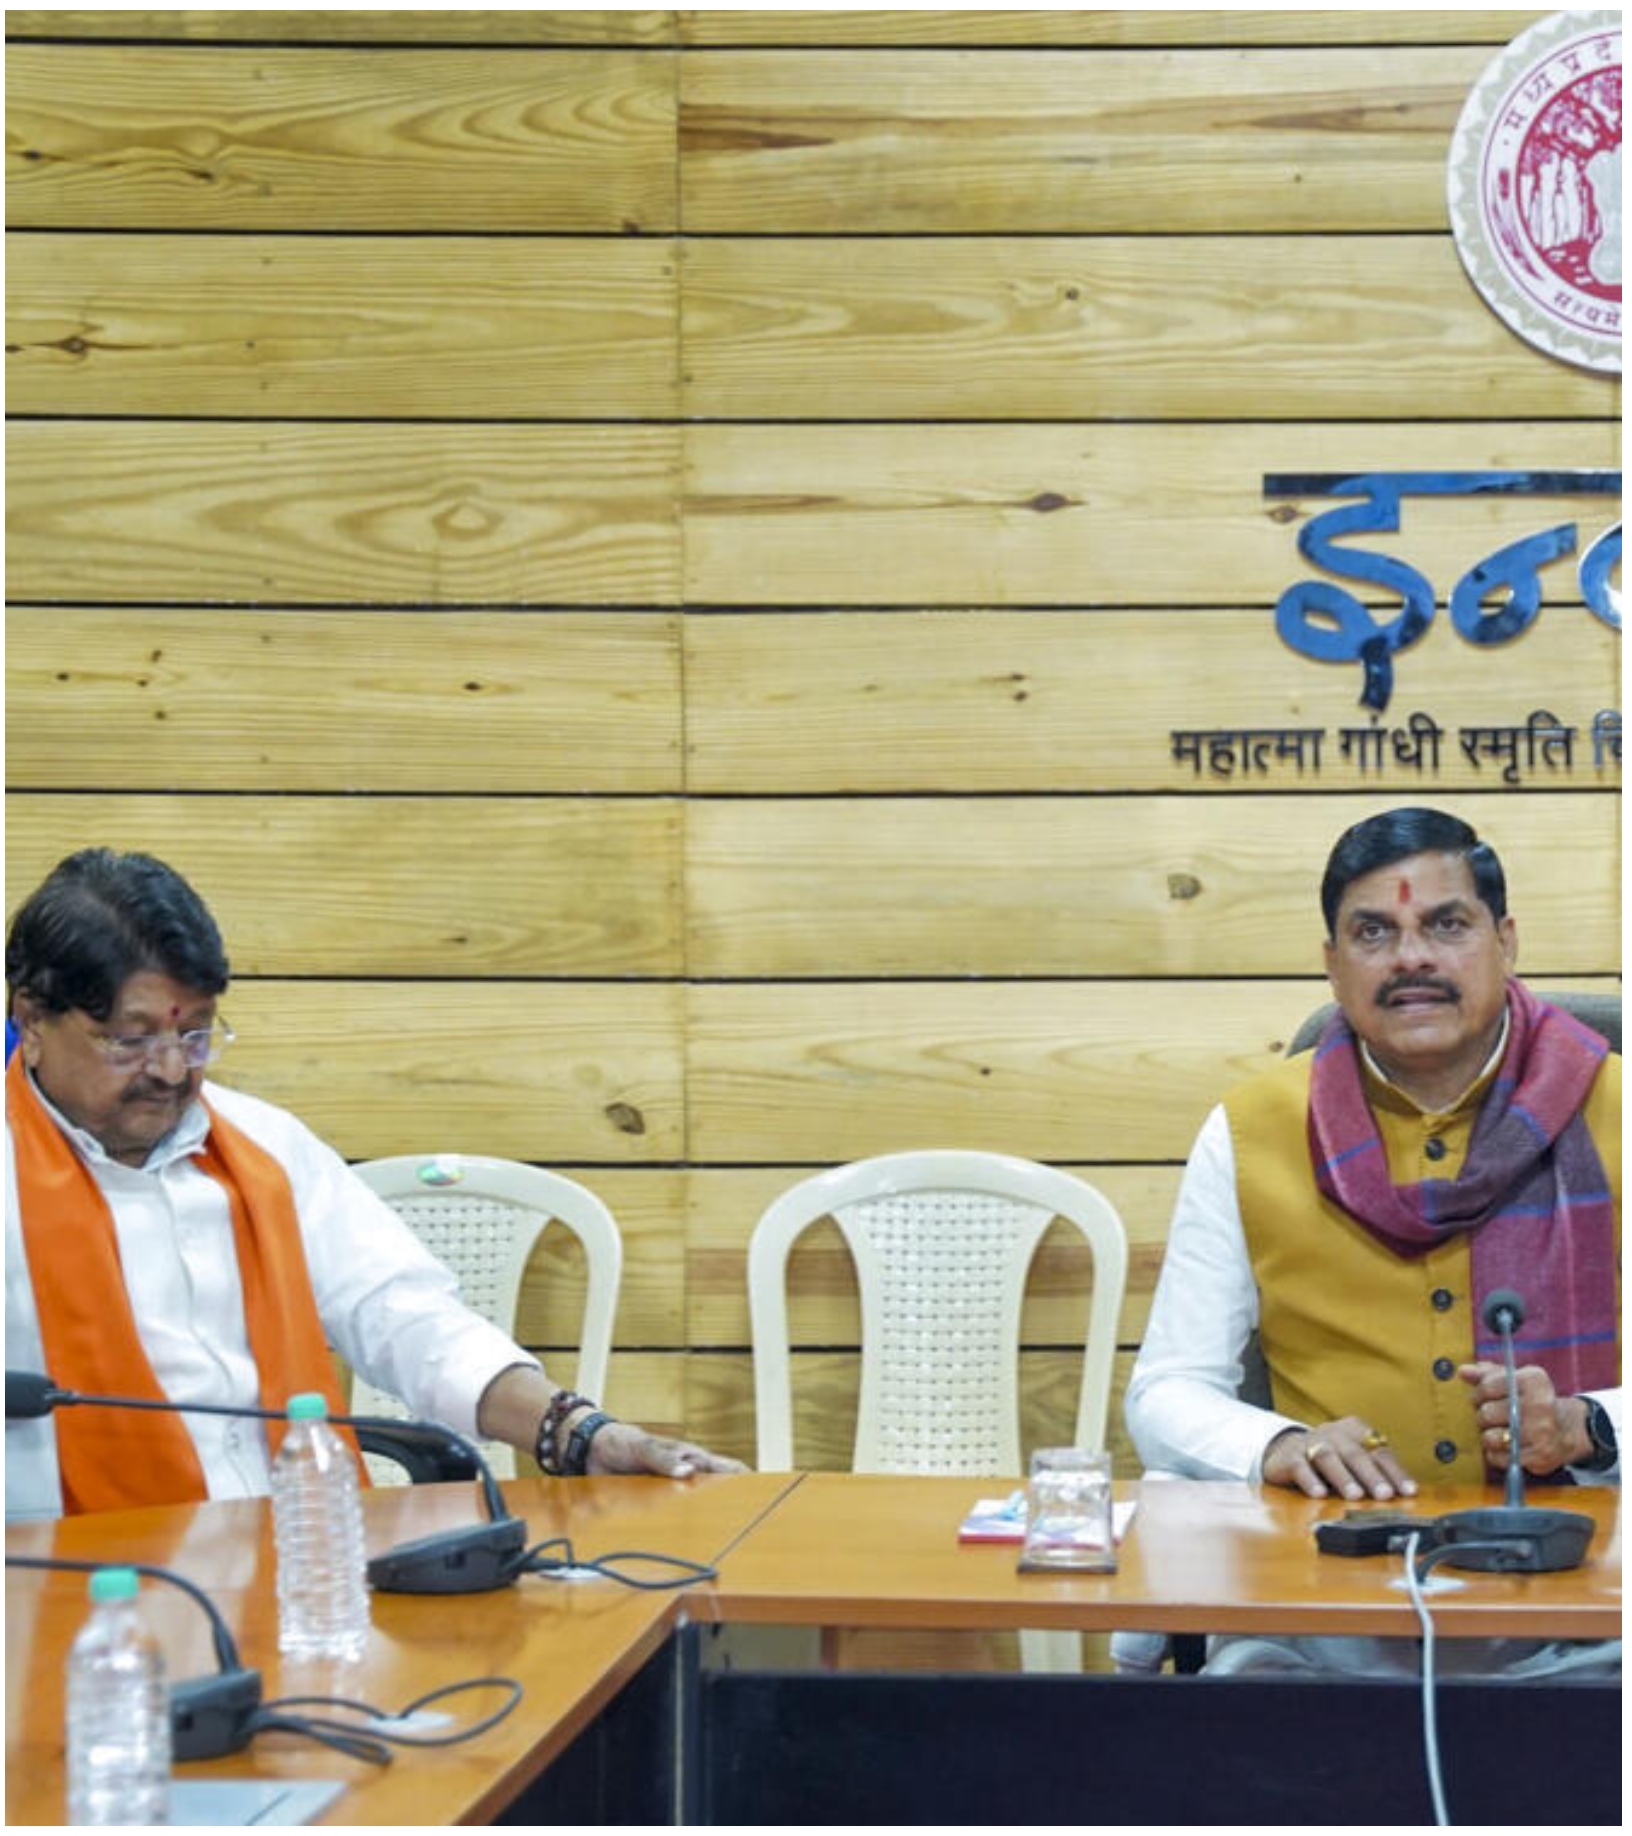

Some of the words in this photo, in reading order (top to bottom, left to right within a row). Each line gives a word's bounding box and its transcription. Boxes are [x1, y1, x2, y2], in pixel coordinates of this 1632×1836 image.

[1170, 727, 1326, 775] महात्मा
[1338, 712, 1445, 773] गांधी
[1458, 709, 1578, 784] स्मृति
